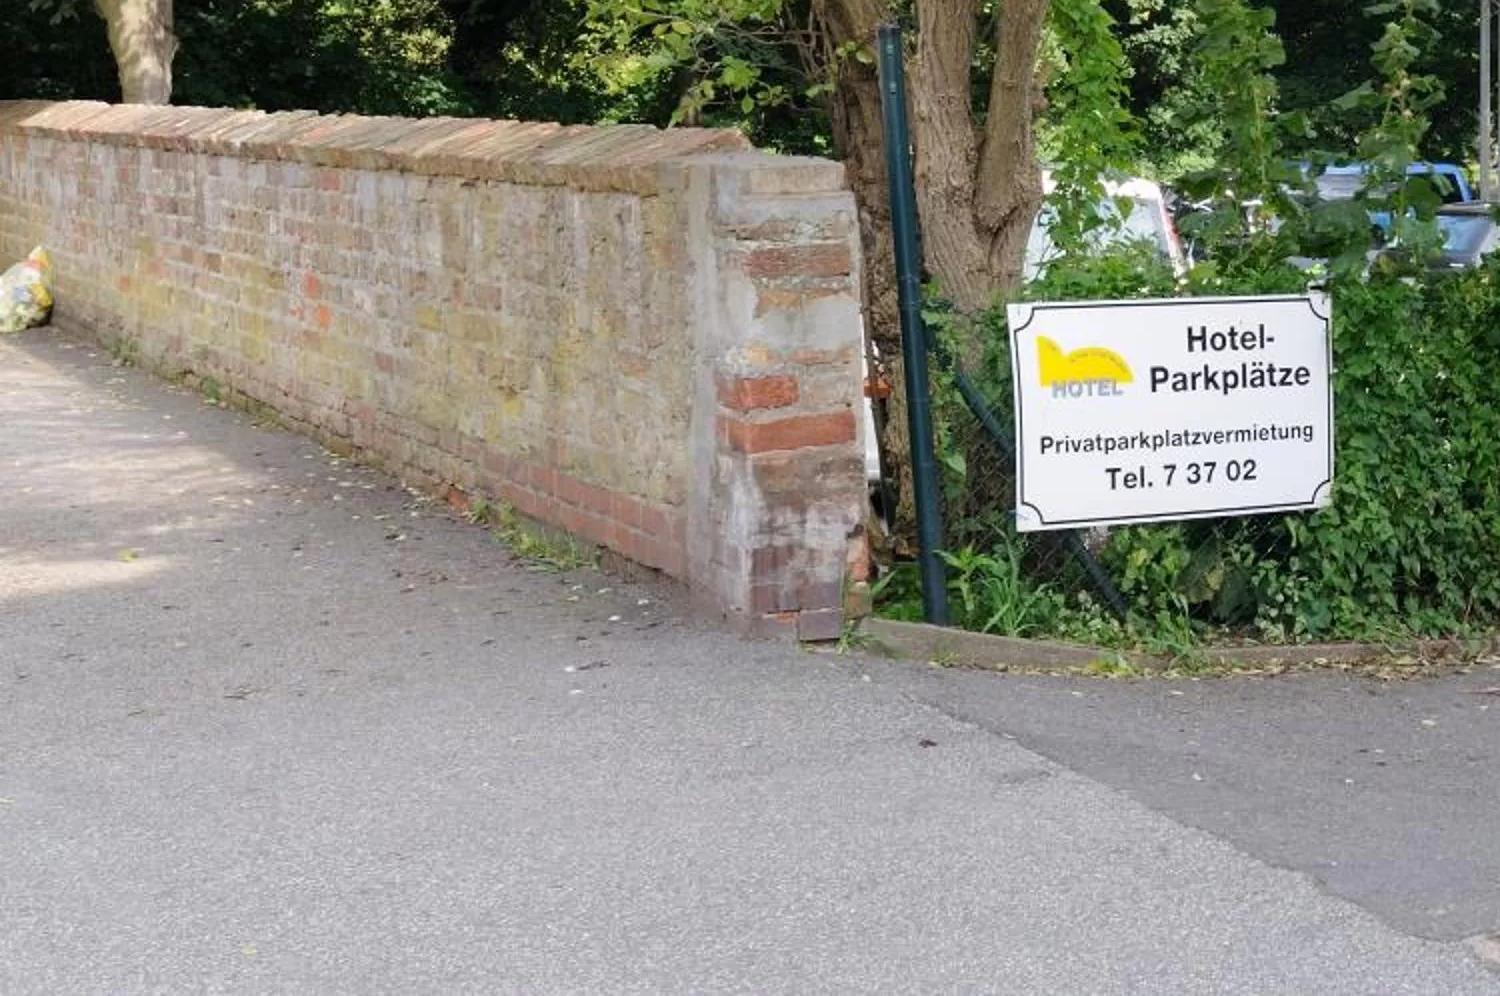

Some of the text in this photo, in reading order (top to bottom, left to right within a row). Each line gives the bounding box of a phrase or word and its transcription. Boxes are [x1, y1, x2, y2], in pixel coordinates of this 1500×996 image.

[1186, 324, 1275, 352] Hotel-
[1052, 379, 1123, 398] HOTEL
[1150, 363, 1311, 395] Parkplätze
[1040, 424, 1313, 455] Privatparkplatzvermietung
[1105, 459, 1257, 490] Tel. 7 37 02
